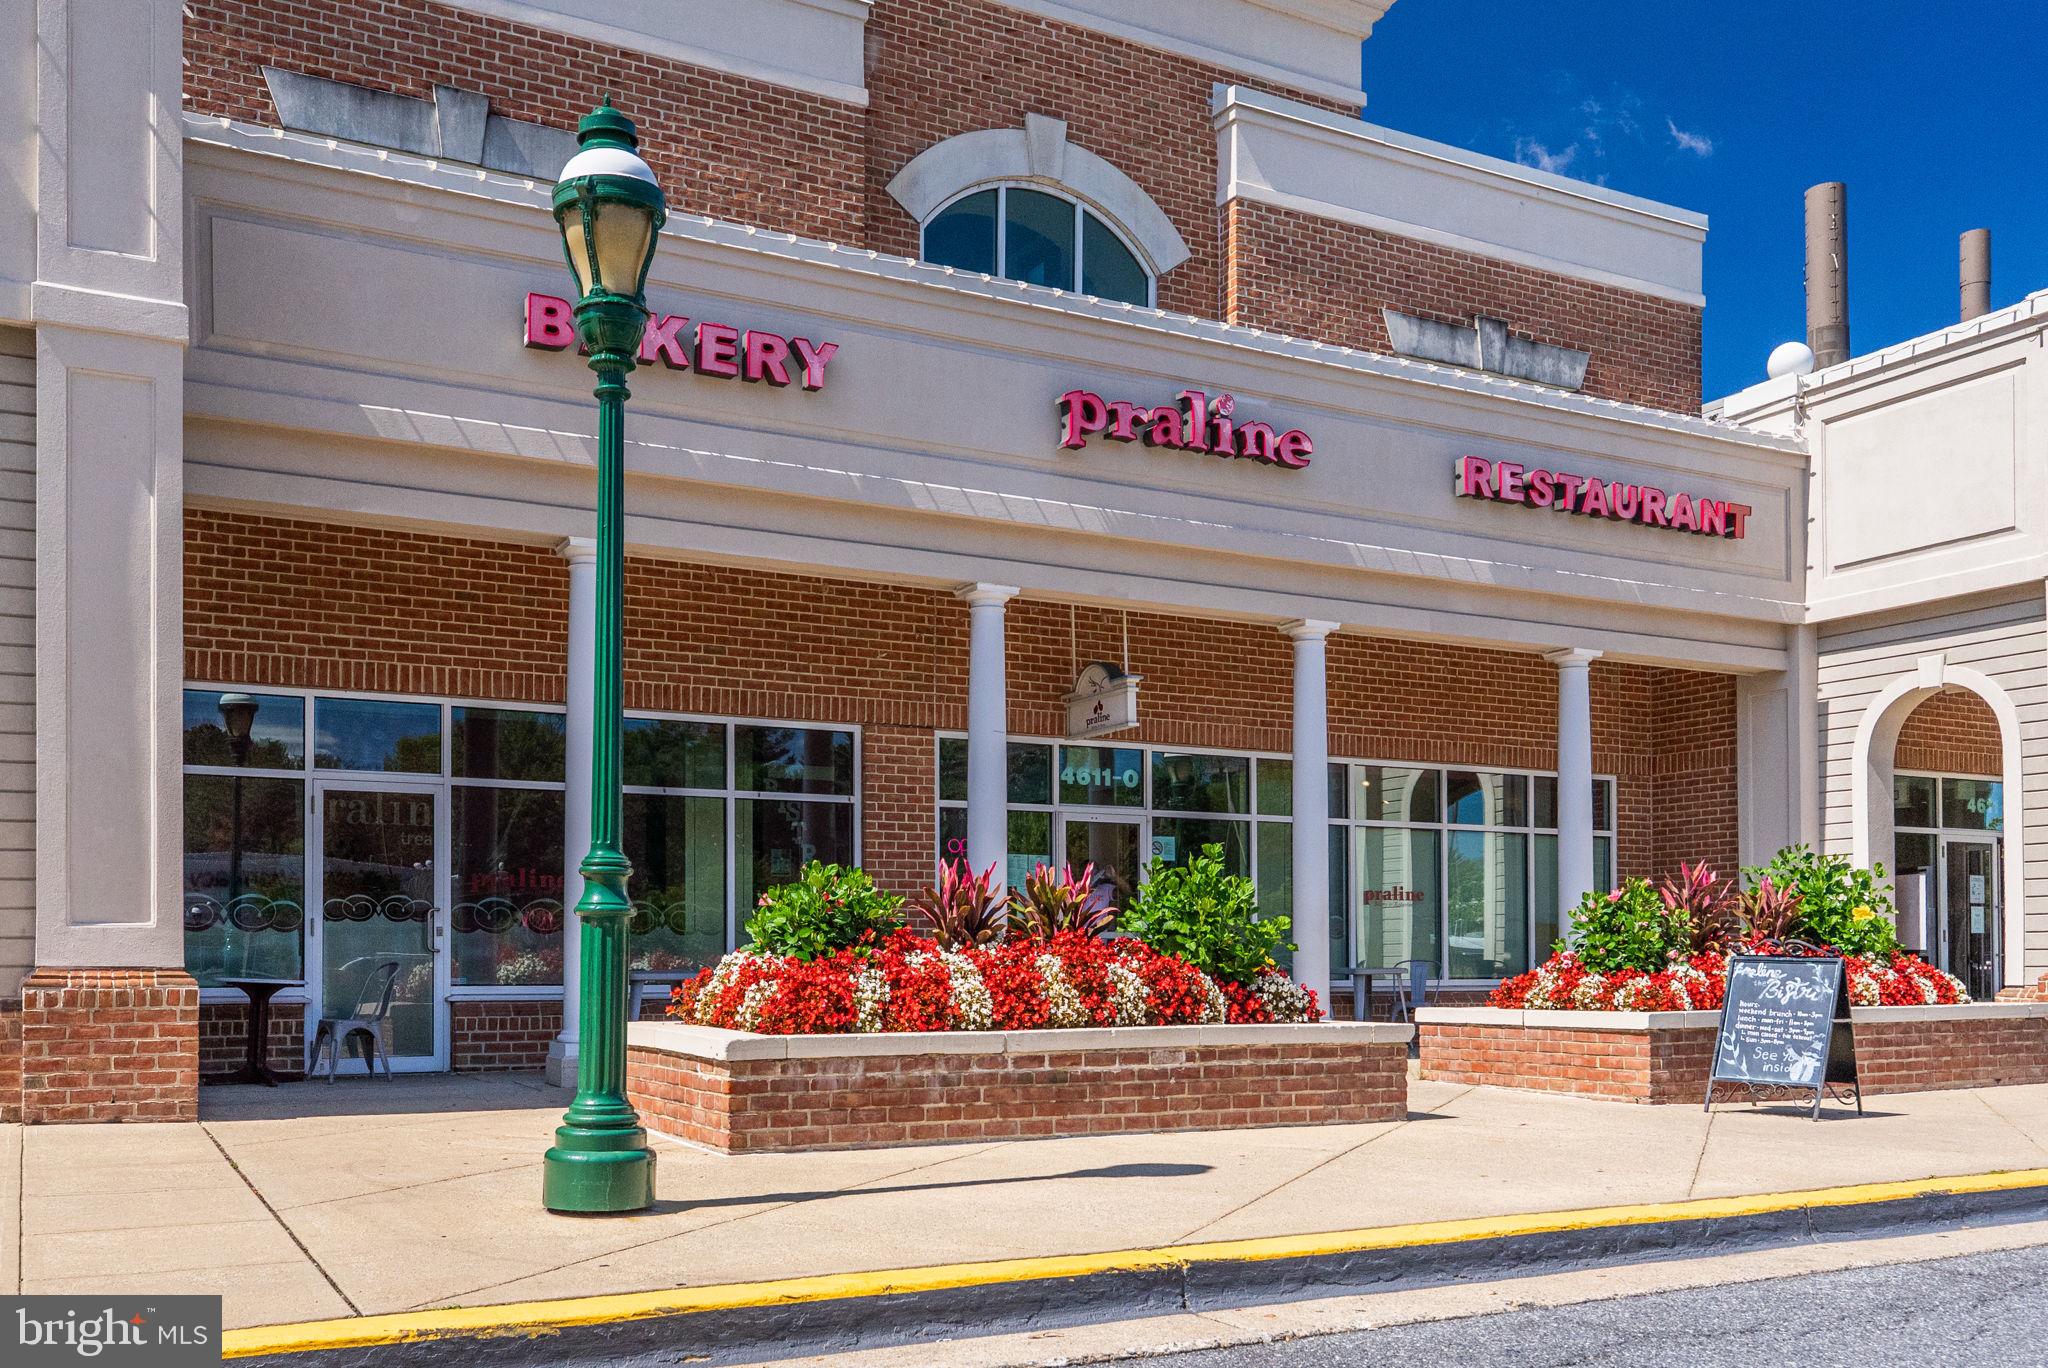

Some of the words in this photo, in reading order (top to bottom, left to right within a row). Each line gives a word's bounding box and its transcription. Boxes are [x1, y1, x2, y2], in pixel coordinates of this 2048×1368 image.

[524, 292, 839, 392] BKERY
[1055, 389, 1313, 470] praline
[1455, 456, 1752, 539] RESTAURANT
[1086, 712, 1110, 728] praline
[1061, 767, 1139, 788] 4611-0
[947, 838, 968, 856] op
[1363, 886, 1424, 905] praline
[1753, 1046, 1778, 1061] See
[1762, 1062, 1792, 1073] insid
